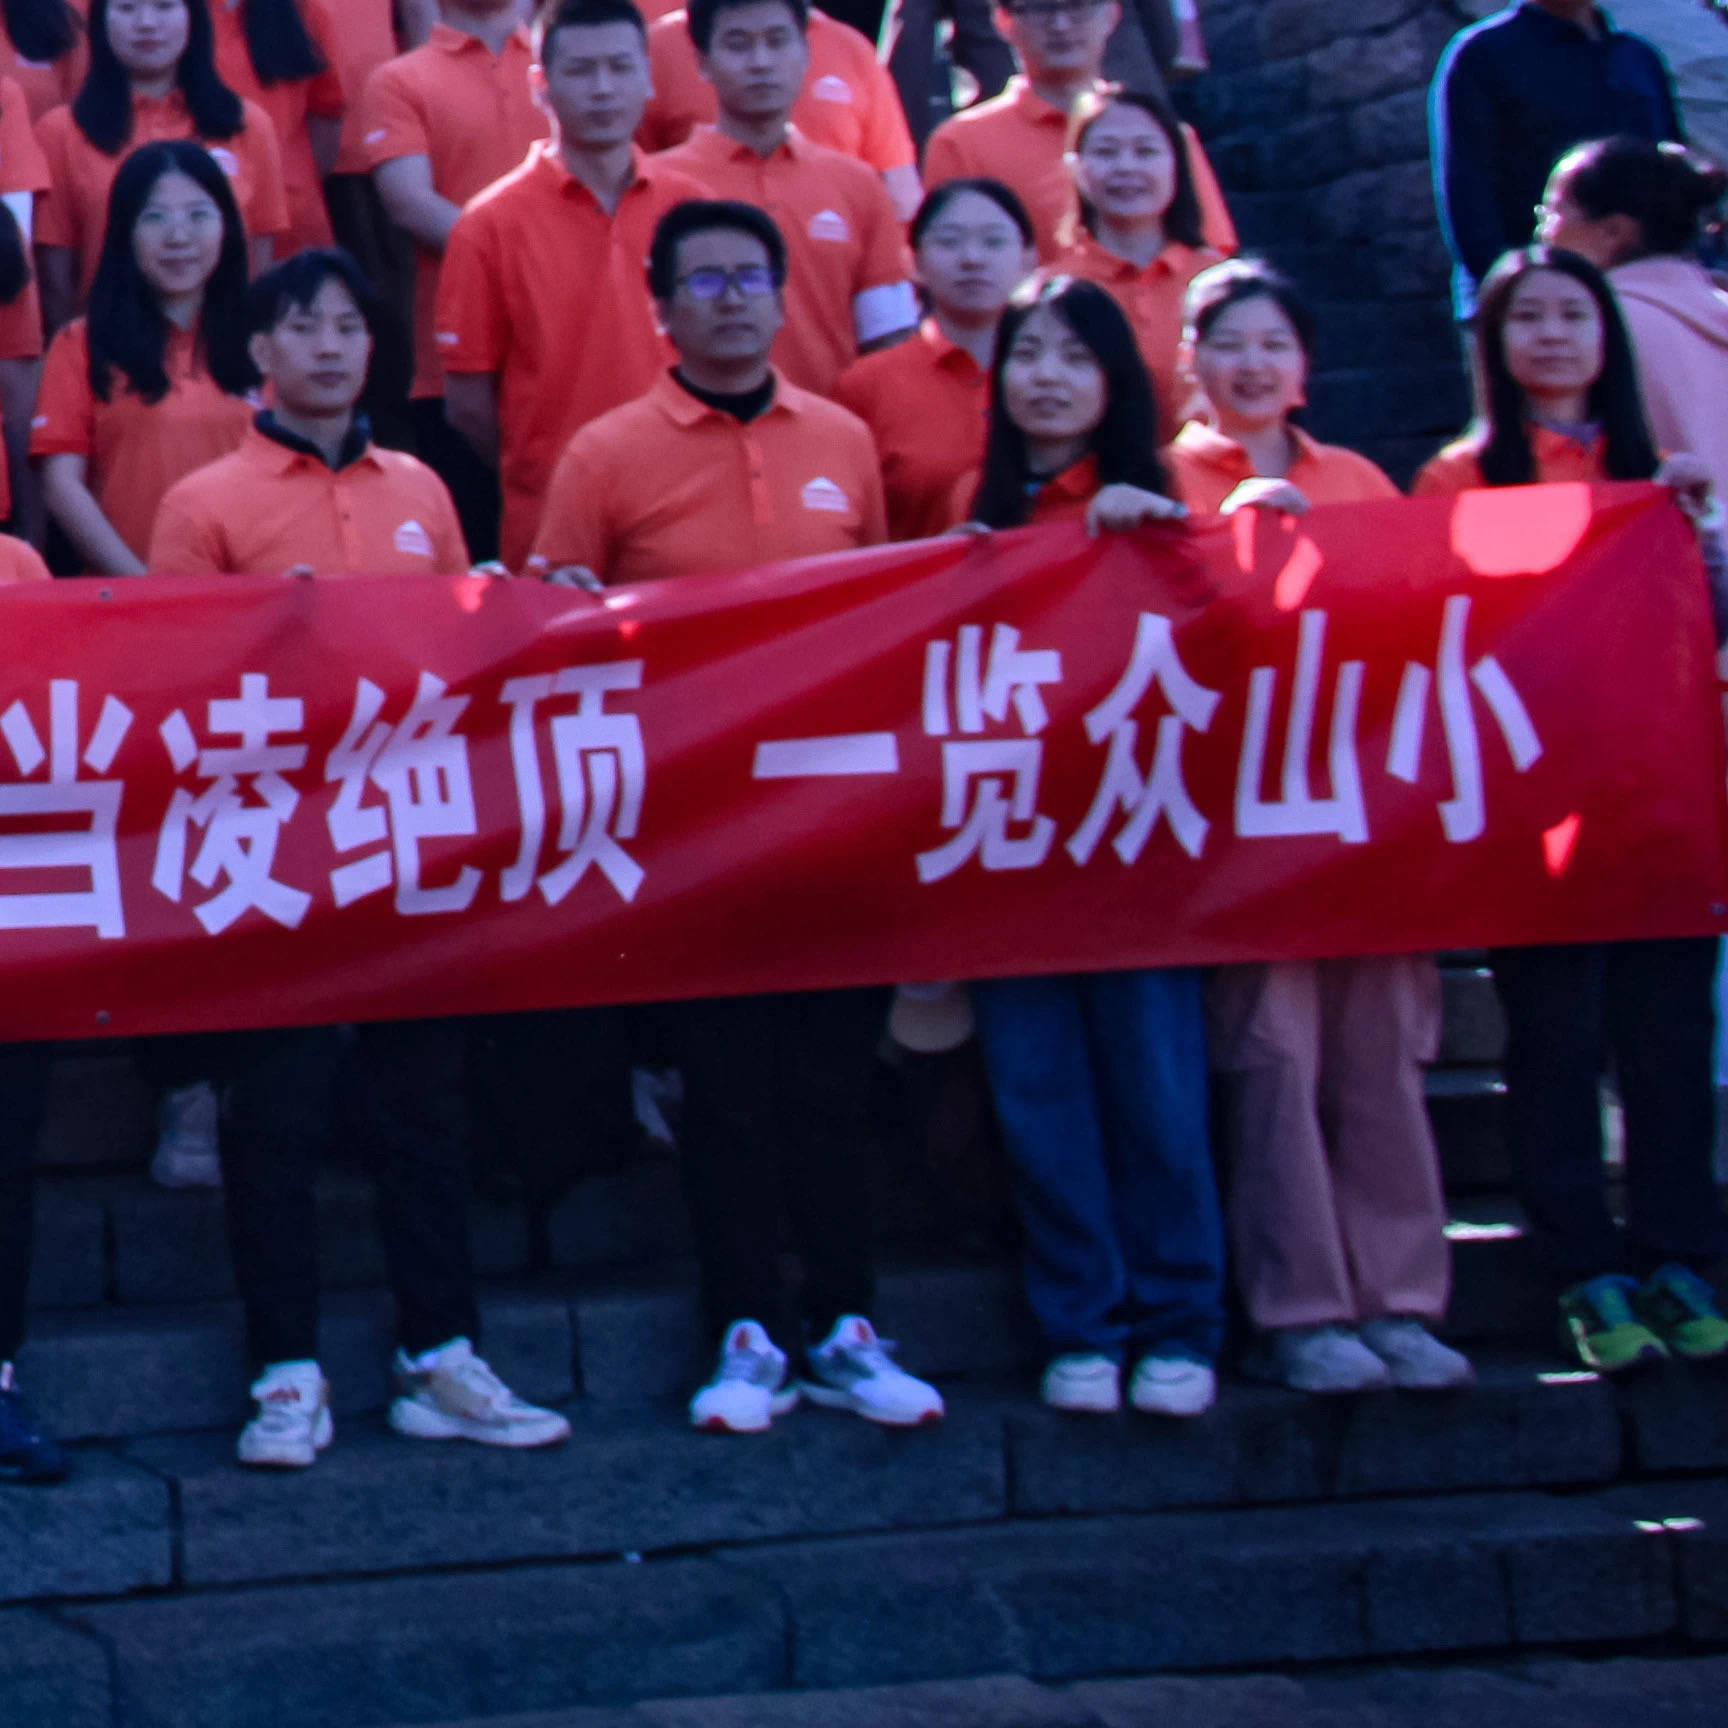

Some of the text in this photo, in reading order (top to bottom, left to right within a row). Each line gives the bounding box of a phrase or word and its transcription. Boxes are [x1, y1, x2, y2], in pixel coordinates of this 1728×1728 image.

[752, 594, 1541, 884] 一览众山小
